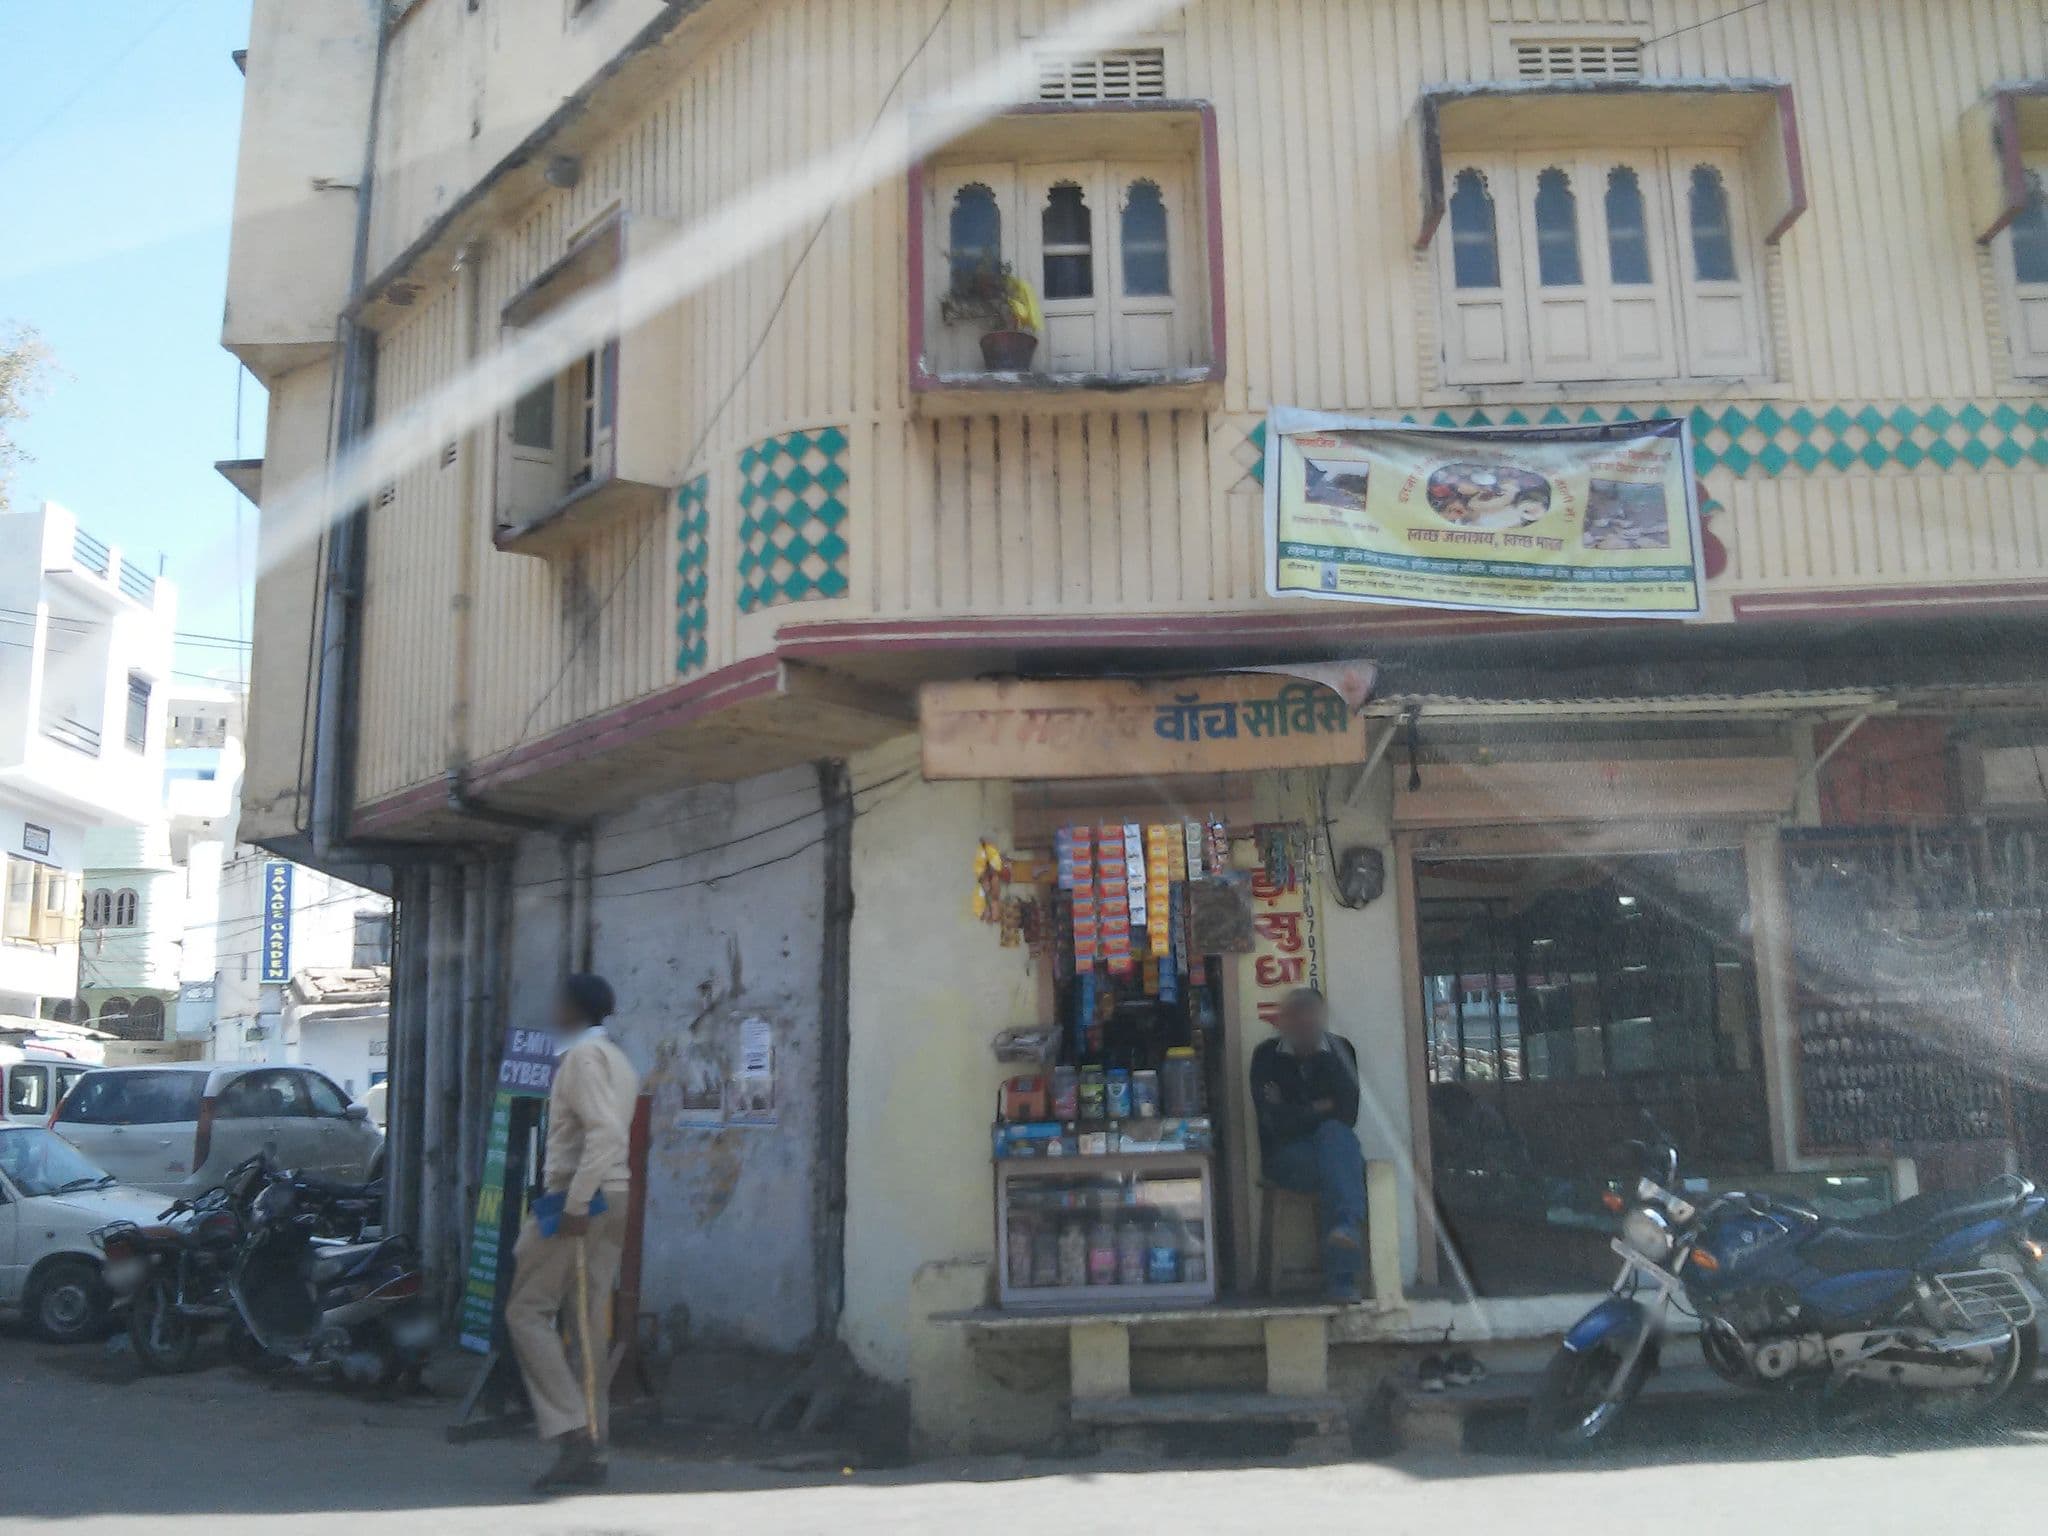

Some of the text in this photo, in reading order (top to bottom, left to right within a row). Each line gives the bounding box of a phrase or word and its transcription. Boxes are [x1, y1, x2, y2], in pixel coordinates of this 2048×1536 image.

[1153, 694, 1239, 743] वॉच
[1242, 683, 1348, 739] सर्विस
[268, 922, 286, 978] GARDEN
[500, 1059, 553, 1088] CYBER
